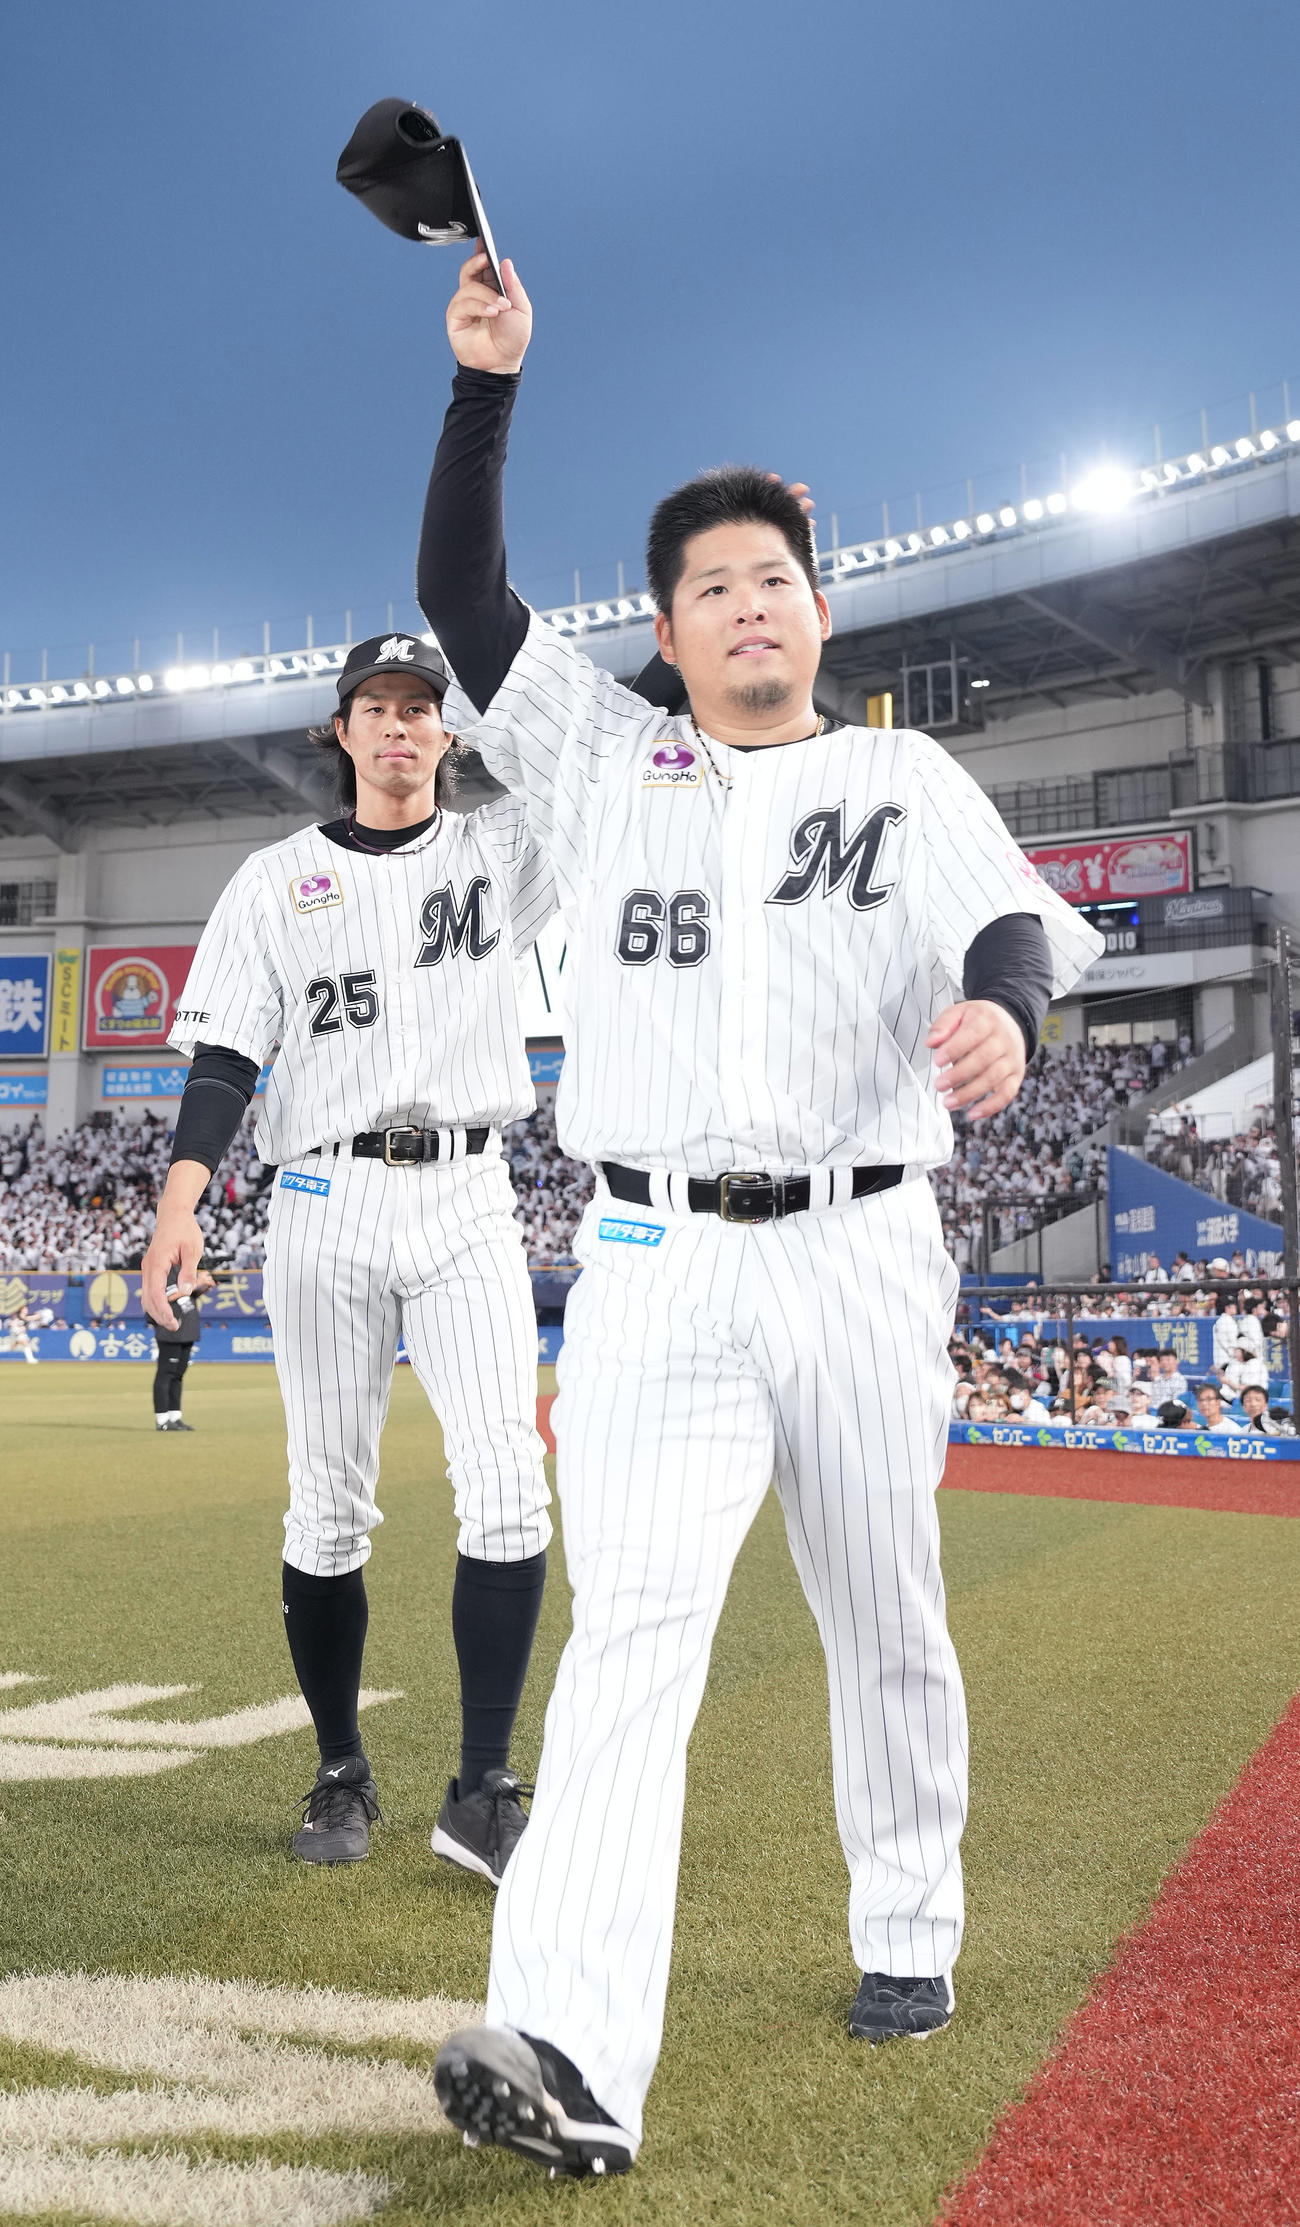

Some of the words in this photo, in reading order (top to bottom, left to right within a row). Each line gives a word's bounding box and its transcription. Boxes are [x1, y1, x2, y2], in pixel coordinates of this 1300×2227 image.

[374, 635, 416, 663] M
[643, 770, 697, 782] GungHo
[765, 799, 907, 911] M
[298, 892, 340, 909] GungHo
[414, 876, 500, 968] M
[614, 888, 710, 968] 66
[305, 969, 380, 1038] 25
[100, 1333, 158, 1359] 古谷
[993, 1427, 1032, 1446] センエー
[1064, 1430, 1106, 1449] センエー
[1143, 1433, 1188, 1455] センエー
[1227, 1437, 1276, 1460] センエー
